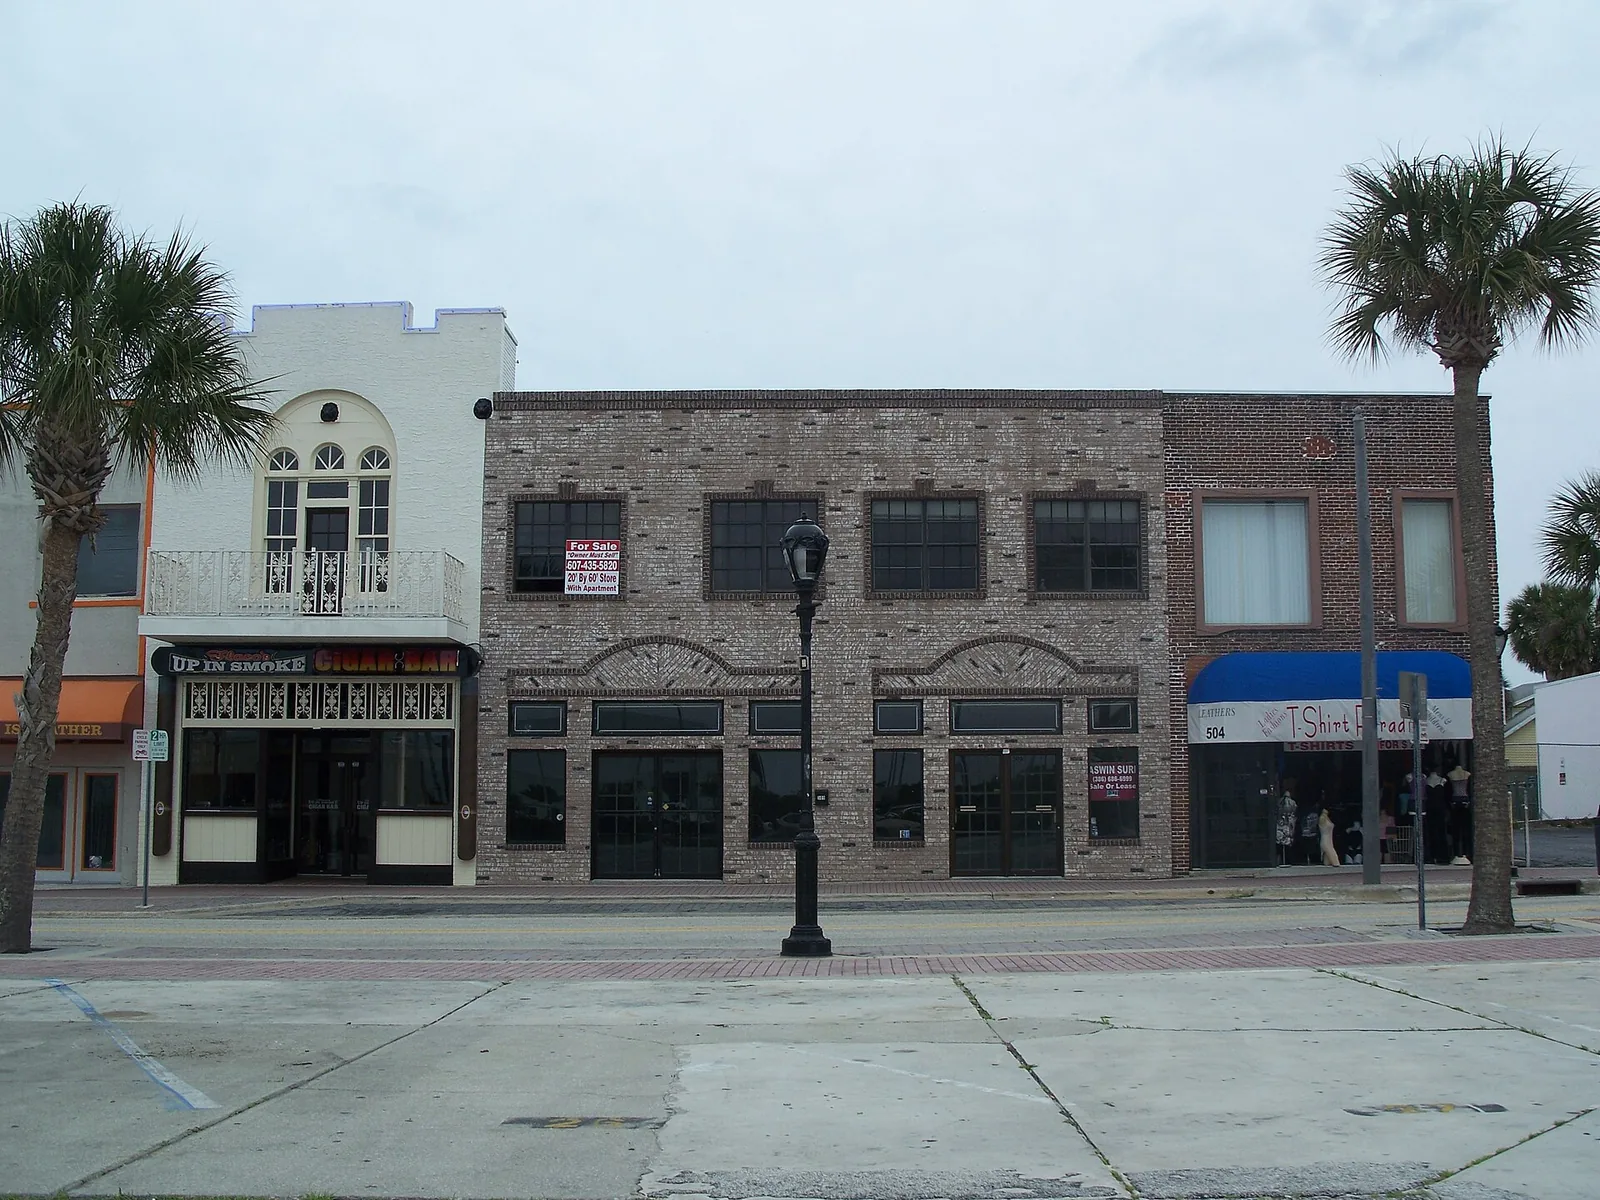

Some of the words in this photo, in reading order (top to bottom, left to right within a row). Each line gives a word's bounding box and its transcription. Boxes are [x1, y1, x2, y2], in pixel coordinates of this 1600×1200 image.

[570, 542, 590, 550] For
[592, 542, 618, 550] Sale
[578, 572, 587, 584] By
[600, 572, 616, 582] Store
[583, 584, 616, 592] Apartment
[172, 655, 200, 672] UP
[202, 660, 226, 672] IN
[230, 656, 306, 672] SMOKE
[404, 650, 456, 672] BAR
[1286, 706, 1350, 738] T-Shirt
[1206, 726, 1226, 739] 504
[1287, 741, 1354, 750] T-SHIRTS
[1380, 740, 1398, 749] FOR
